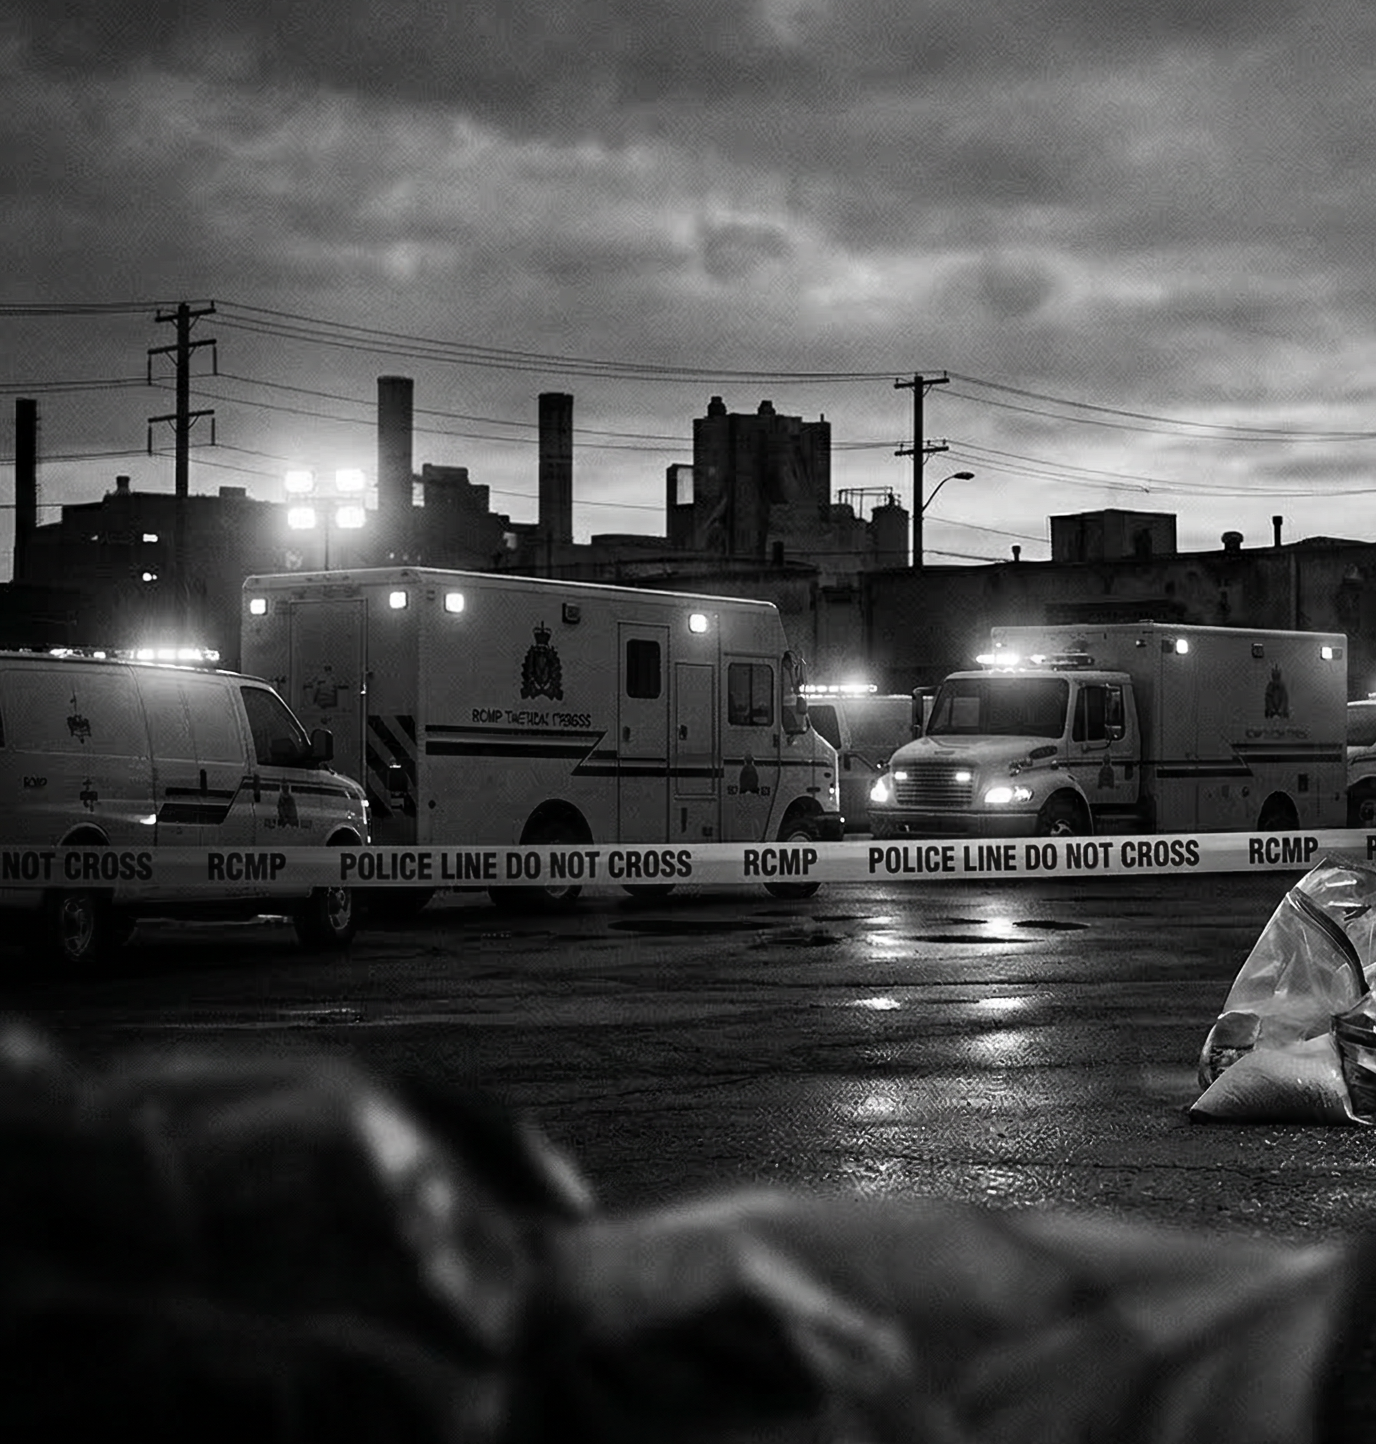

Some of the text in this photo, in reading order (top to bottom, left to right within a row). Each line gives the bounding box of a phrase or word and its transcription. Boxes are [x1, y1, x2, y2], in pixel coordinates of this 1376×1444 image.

[3, 852, 55, 880] NOT
[64, 852, 152, 880] CROSS
[208, 853, 286, 881] RCMP
[340, 853, 432, 881] POLICE
[441, 853, 497, 880] LINE
[506, 852, 541, 879] DO
[550, 852, 600, 879] NOT
[608, 850, 692, 878] CROSS
[744, 849, 817, 876] RCMP
[869, 846, 955, 874] POLICE
[964, 845, 1017, 871] LINE
[1026, 844, 1057, 870] DO
[1066, 842, 1113, 869] NOT
[1121, 840, 1200, 868] CROSS
[1250, 837, 1318, 864] RCMP
